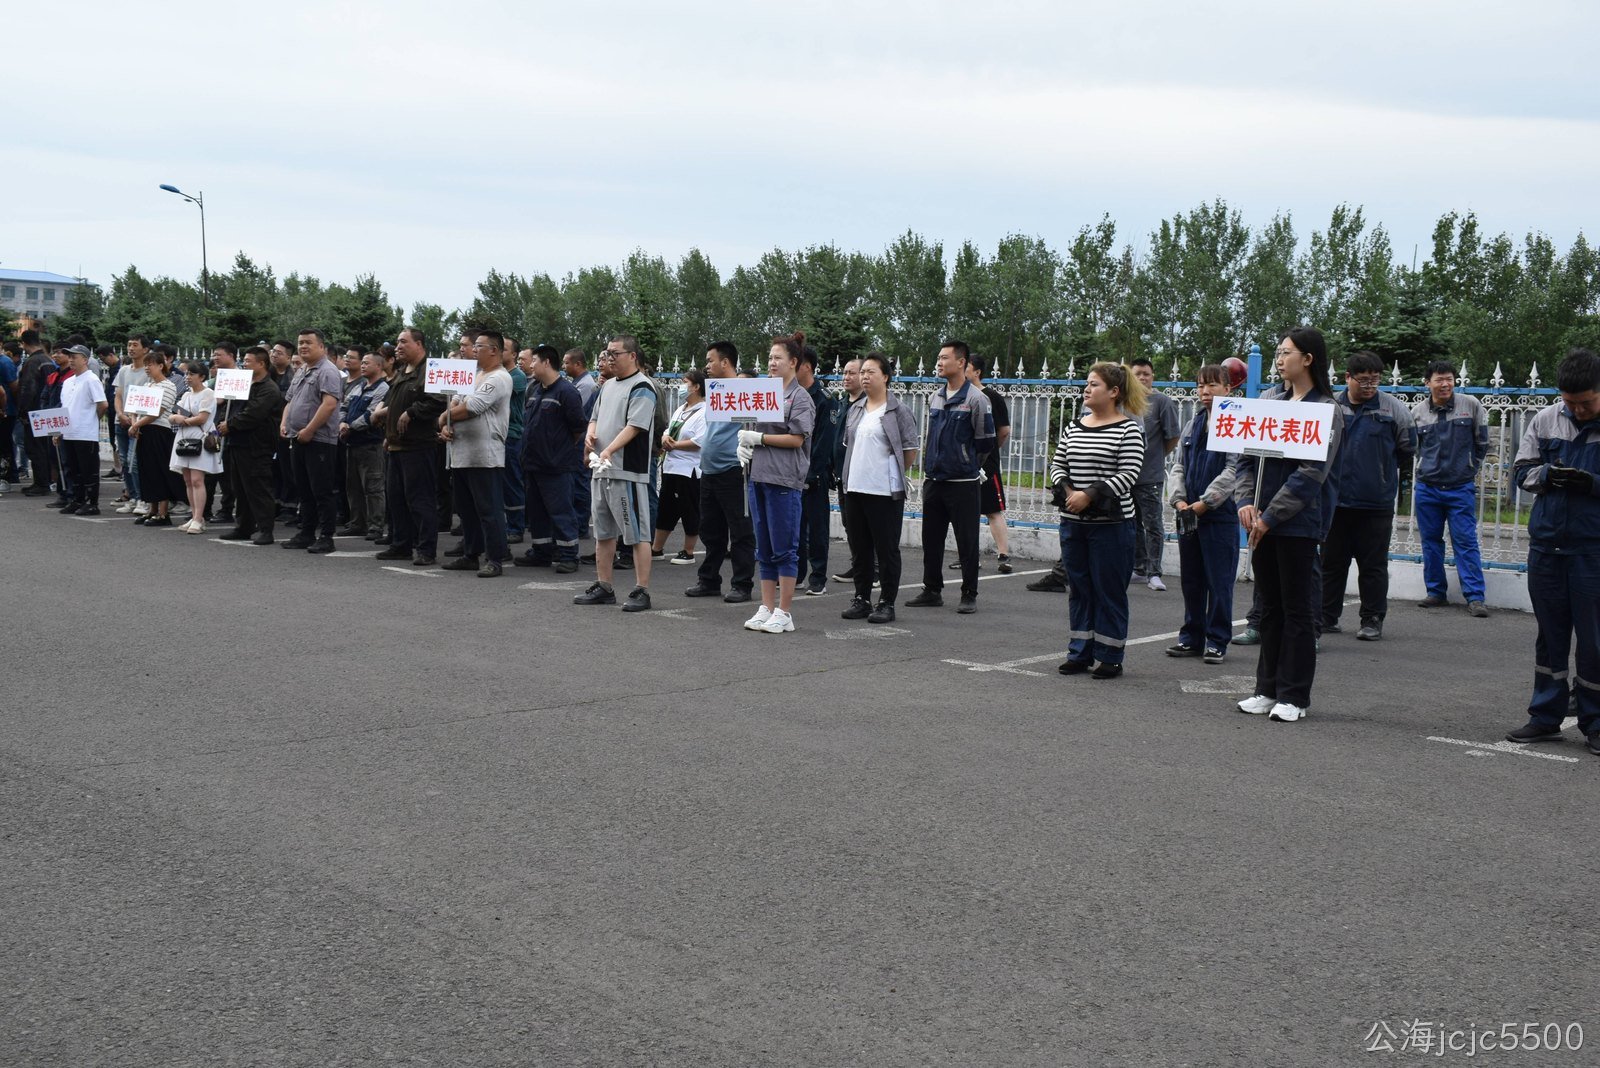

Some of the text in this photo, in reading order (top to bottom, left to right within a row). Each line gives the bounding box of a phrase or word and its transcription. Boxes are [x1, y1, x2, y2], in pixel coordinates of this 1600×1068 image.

[217, 378, 249, 391] 生产代表队5
[428, 369, 473, 386] 生产代表队6
[709, 391, 779, 411] 机关代表队
[33, 416, 70, 431] 生产代表队3
[1215, 413, 1322, 446] 技术代表队
